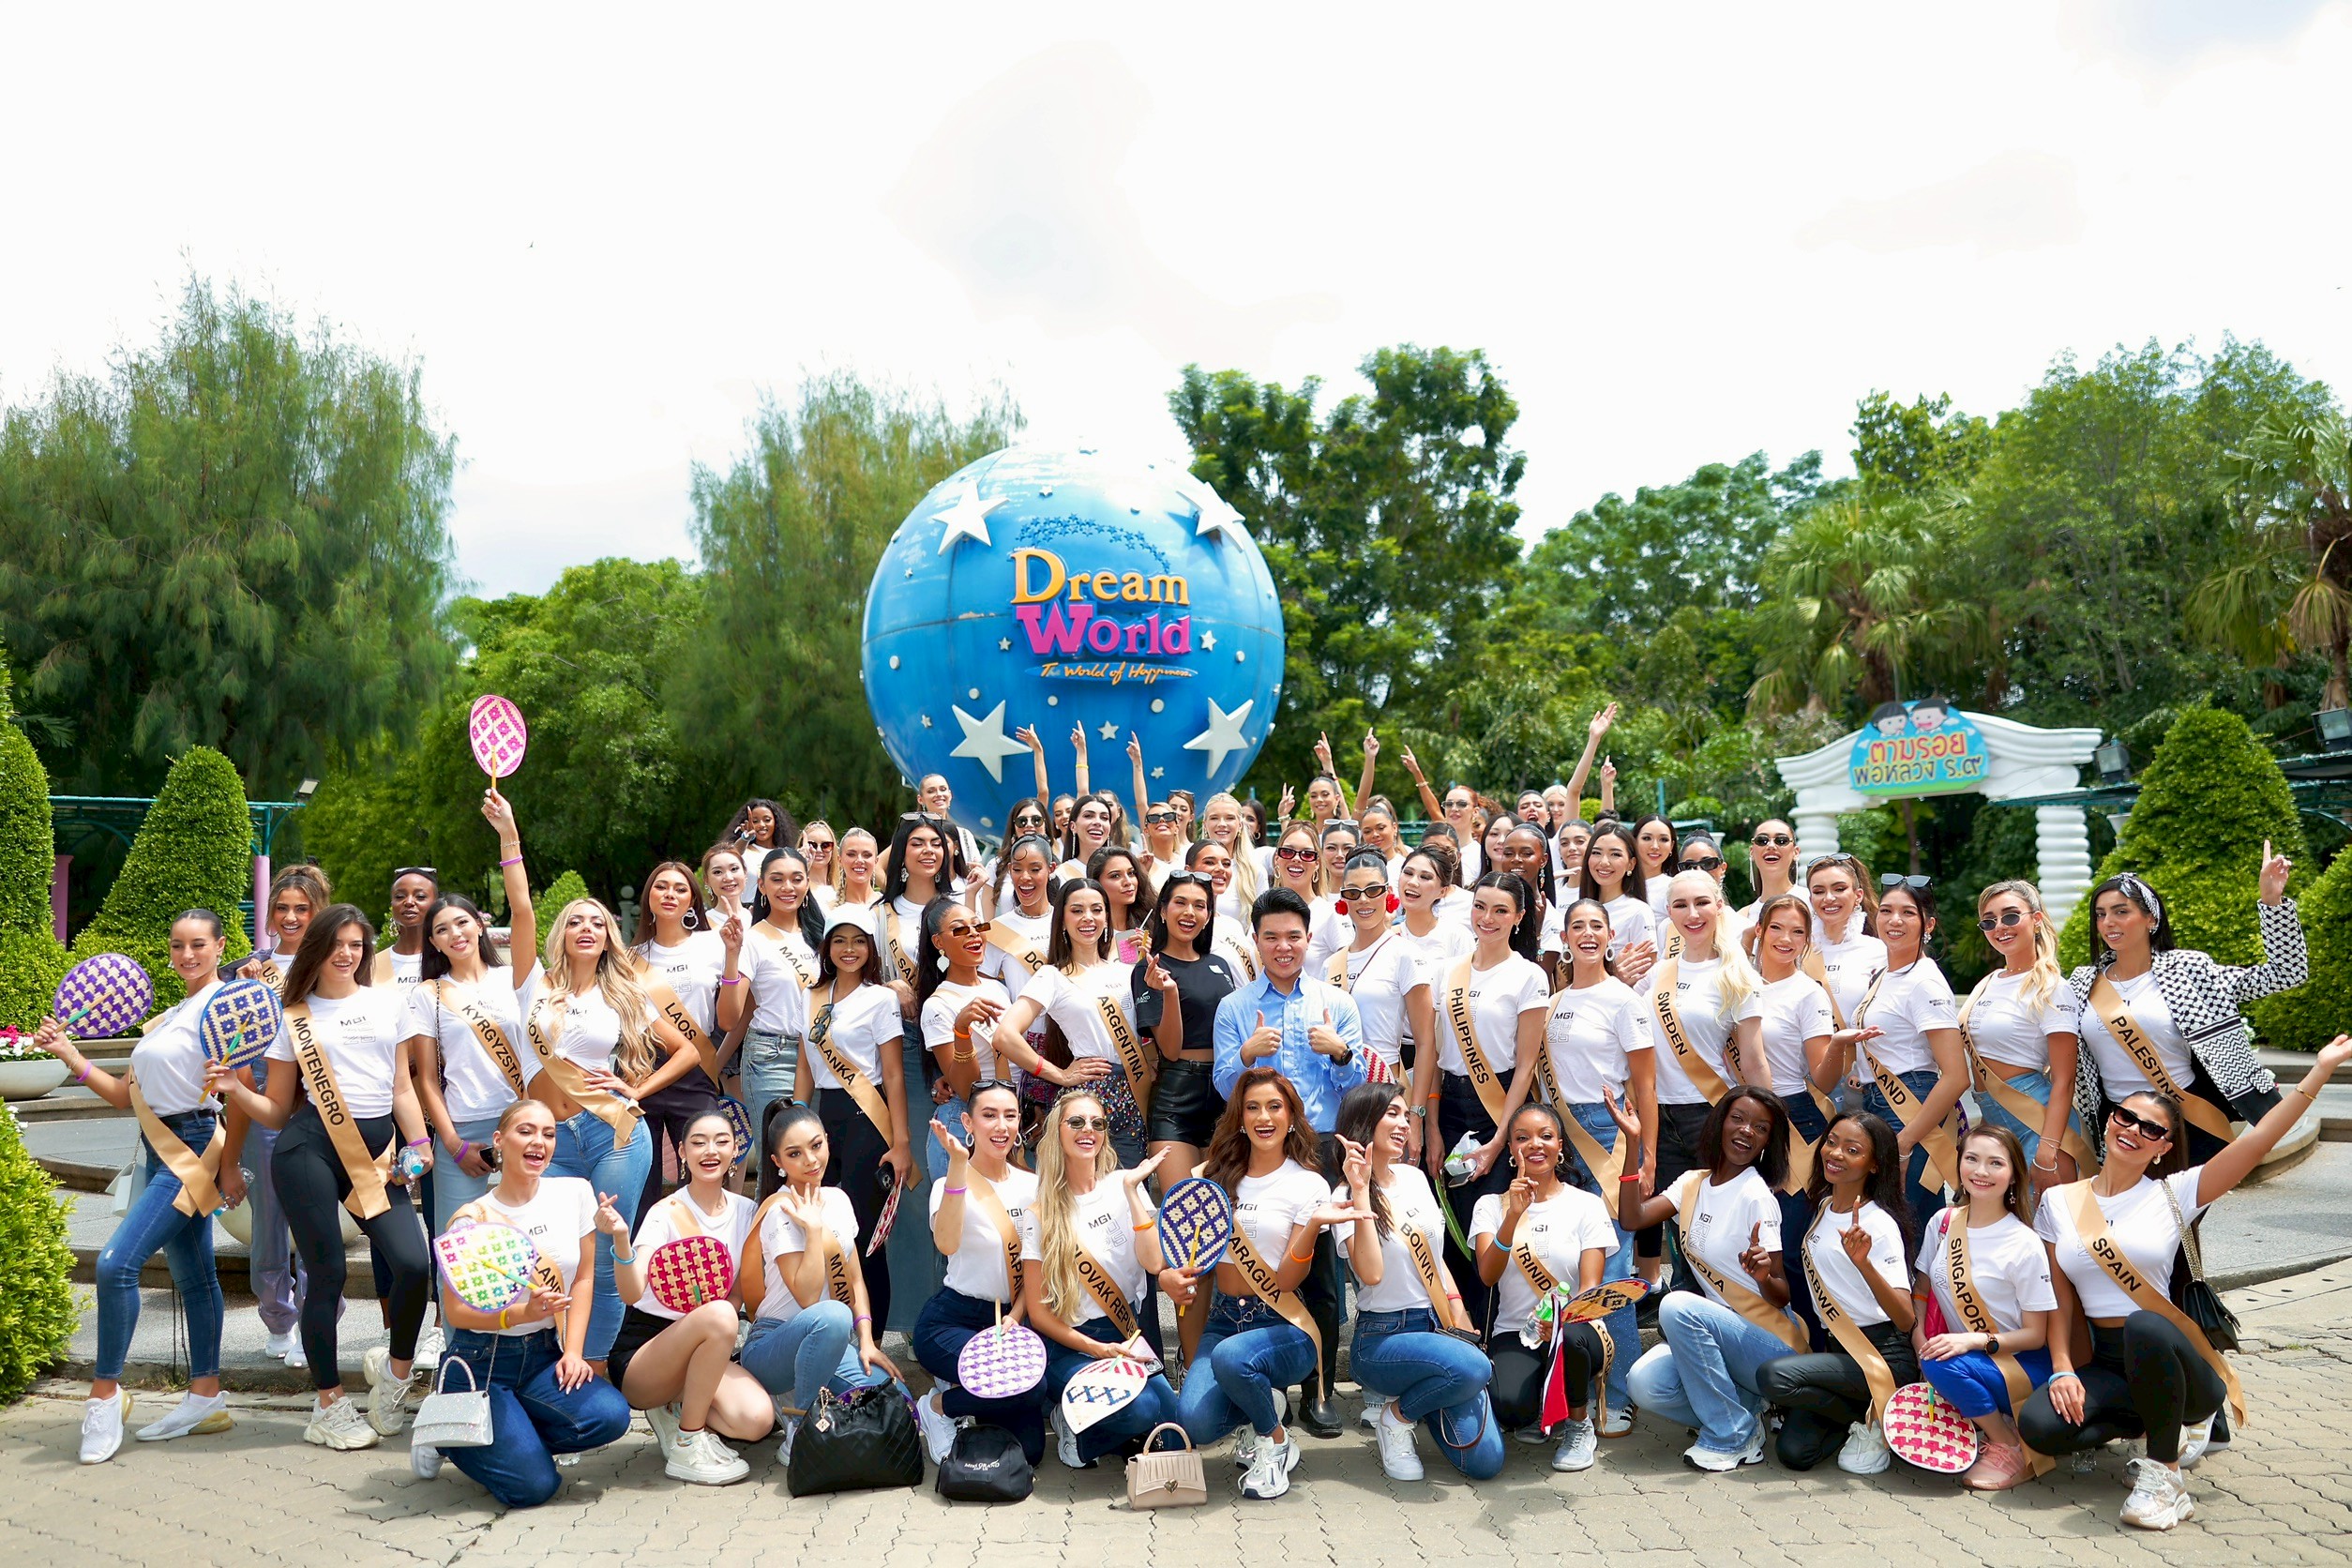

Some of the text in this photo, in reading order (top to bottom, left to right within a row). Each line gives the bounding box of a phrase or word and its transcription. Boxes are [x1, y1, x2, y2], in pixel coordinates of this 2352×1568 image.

[1010, 548, 1190, 606] Dream
[1016, 601, 1192, 655] World
[1064, 663, 1106, 677] World
[1109, 661, 1126, 686] of
[1854, 759, 1935, 785] พ่อหลวง
[1870, 733, 1966, 763] ตามรอย
[263, 966, 279, 985] US
[527, 998, 549, 1056] KOSOVO
[664, 1002, 697, 1042] LAOS
[1097, 995, 1144, 1083] ARGENTINA
[1451, 988, 1489, 1085] PHILIPPINES
[1658, 991, 1688, 1056] SWEDEN
[293, 1017, 345, 1126] MONTENEGRO
[819, 1038, 856, 1086] LANKA
[1088, 1213, 1112, 1229] MGI
[1400, 1222, 1435, 1288] BOLIVIA
[2092, 1237, 2142, 1292] SPAIN
